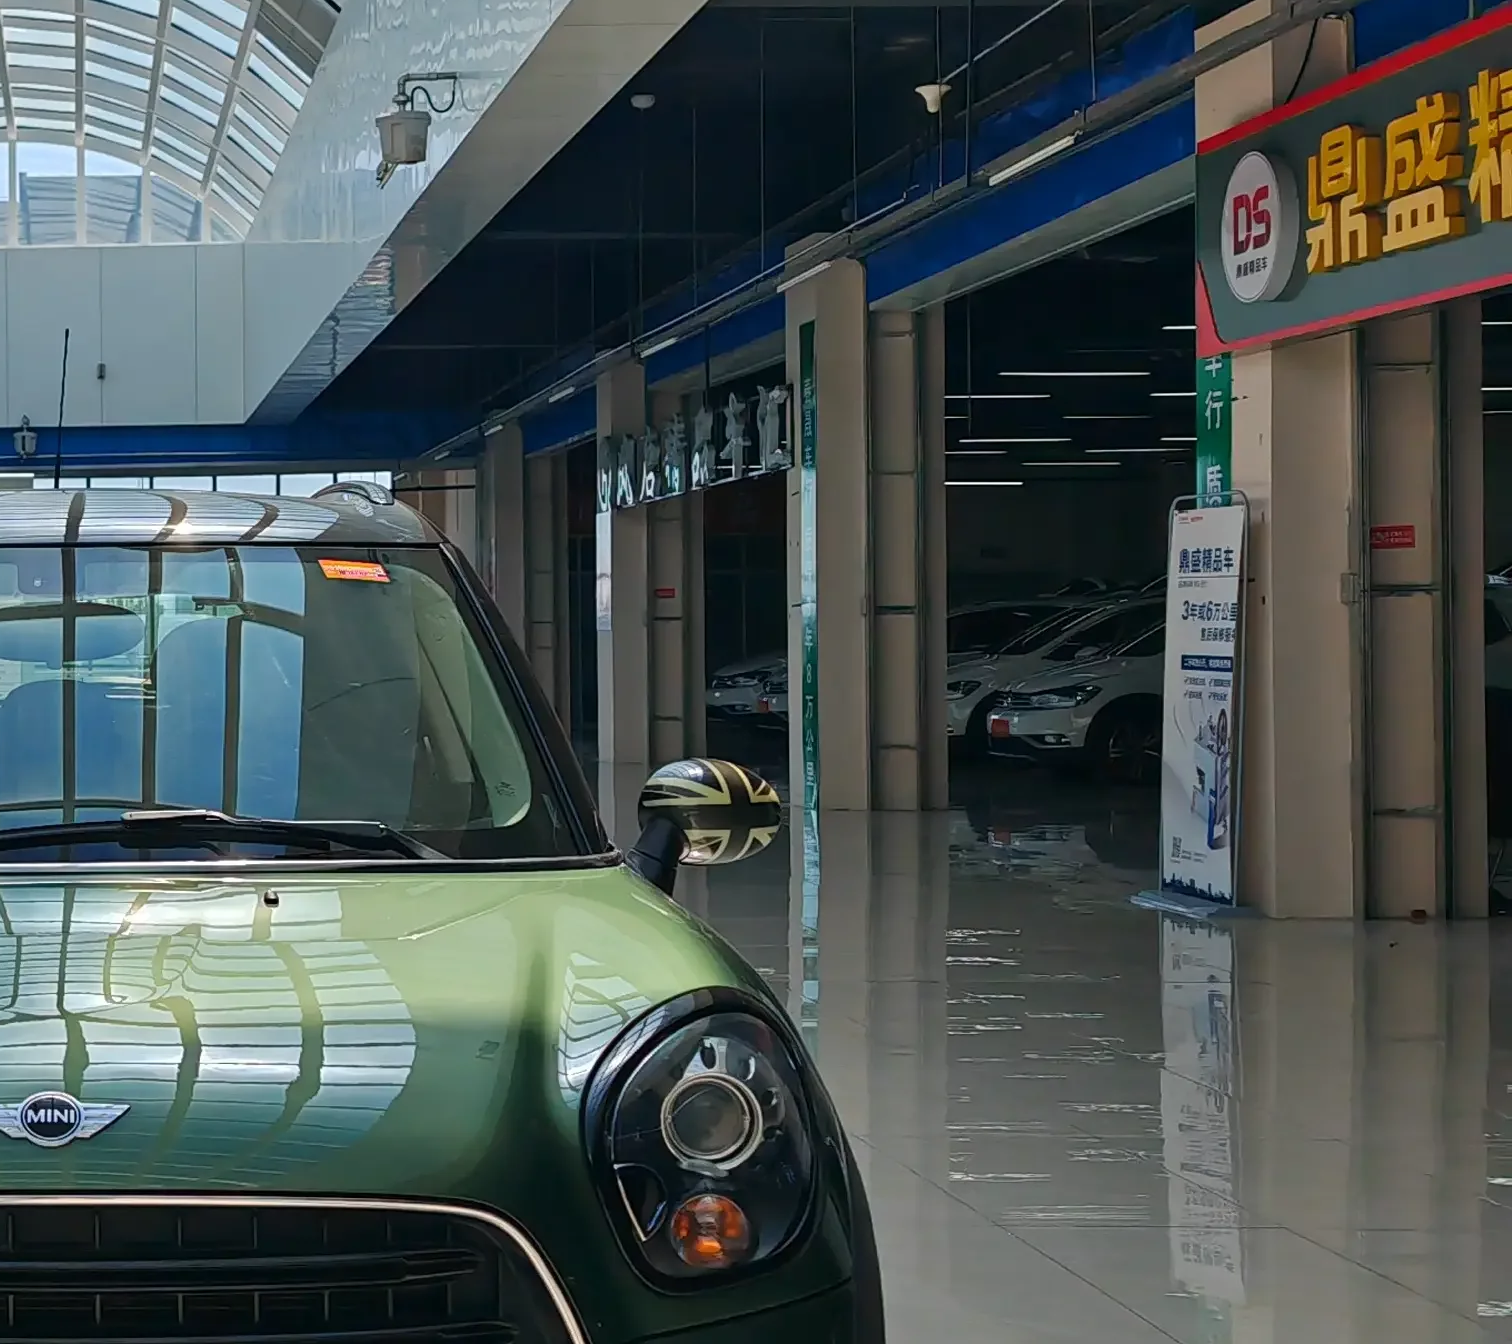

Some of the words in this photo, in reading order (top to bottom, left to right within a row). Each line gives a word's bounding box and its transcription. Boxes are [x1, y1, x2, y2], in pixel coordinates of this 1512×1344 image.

[1233, 185, 1271, 256] DS
[1179, 546, 1234, 573] 鼎盛精品车
[27, 1109, 75, 1124] MINI
